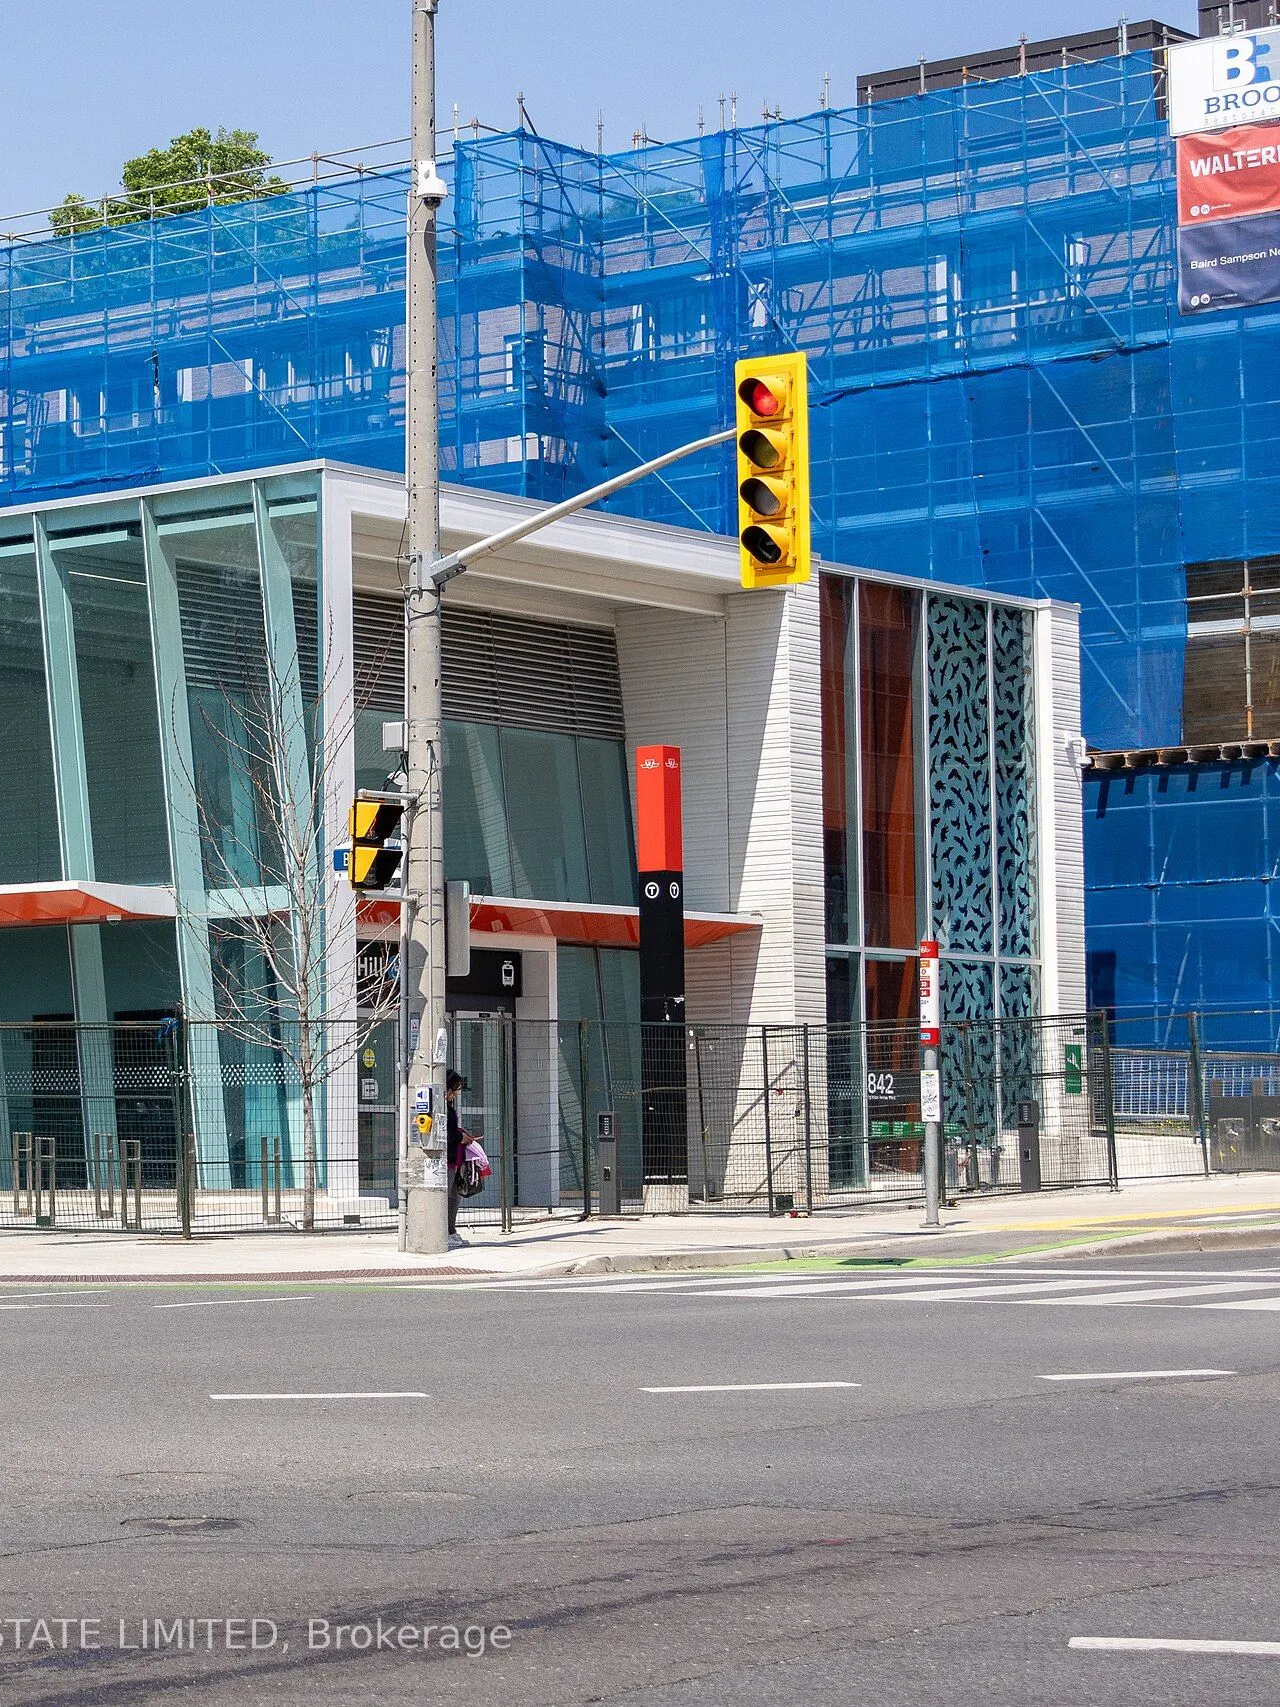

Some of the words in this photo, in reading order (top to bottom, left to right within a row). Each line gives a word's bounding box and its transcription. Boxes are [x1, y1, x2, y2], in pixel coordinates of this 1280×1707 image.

[1190, 258, 1218, 270] Baird
[1220, 251, 1267, 266] Sampson
[867, 1072, 895, 1095] 842
